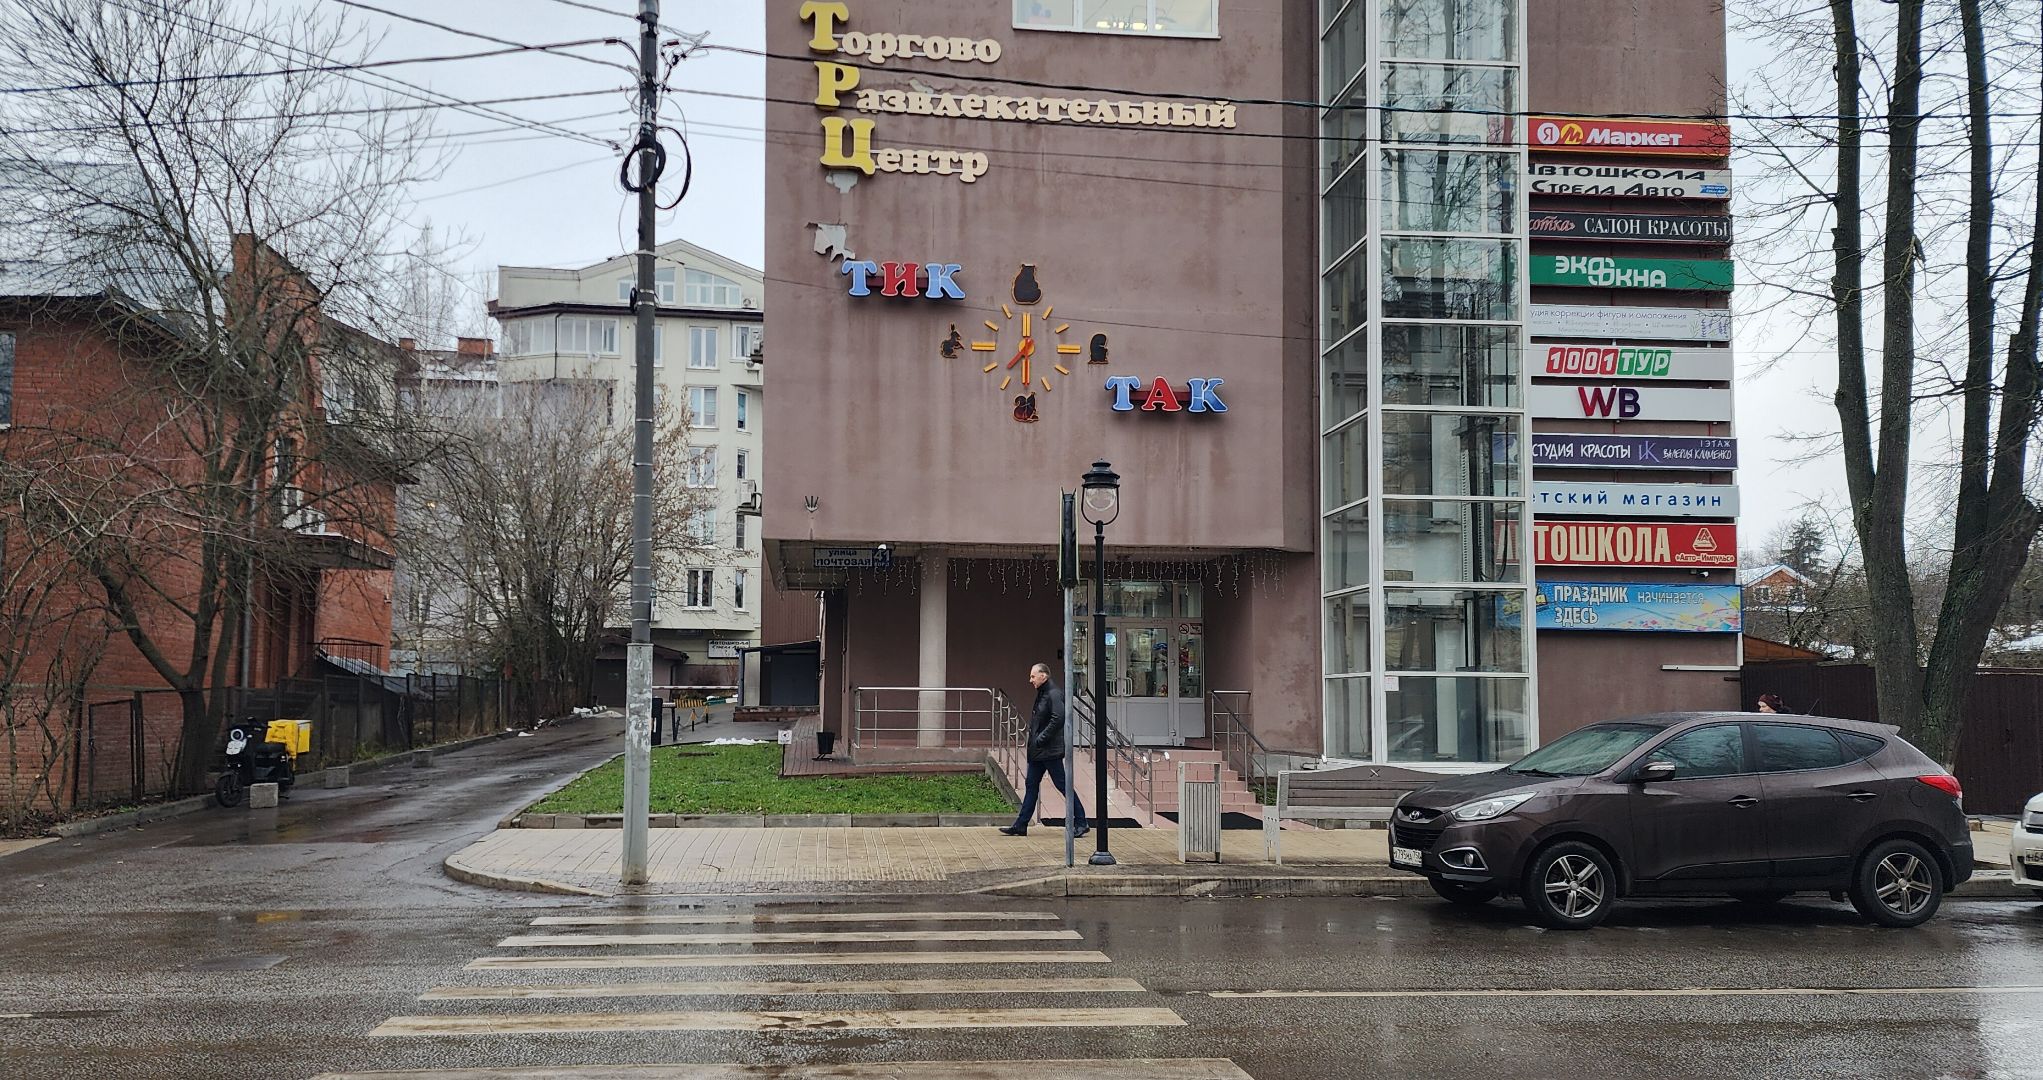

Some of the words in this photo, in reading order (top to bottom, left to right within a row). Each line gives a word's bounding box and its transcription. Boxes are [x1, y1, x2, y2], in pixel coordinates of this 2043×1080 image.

[800, 1, 1001, 64] Торгово
[814, 61, 1237, 128] Развлекательный
[1586, 128, 1682, 146] Маркет
[820, 117, 989, 183] Центр
[1584, 217, 1641, 234] САЛОН
[1647, 221, 1729, 237] КРАСОТЫ
[842, 260, 965, 299] ТИК
[1105, 375, 1229, 413] ТАК
[1578, 387, 1640, 417] WB
[1532, 443, 1573, 460] СТУДИЯ
[1581, 444, 1630, 459] КРАСОТЫ
[1705, 440, 1730, 448] ЭТАЖ
[1623, 493, 1721, 506] магазин
[816, 559, 872, 567] ПОЧТОВАЯ
[873, 549, 890, 561] 41
[828, 549, 857, 557] улица
[1554, 586, 1628, 604] ПРАЗДНИК
[1637, 591, 1704, 604] начинается
[1554, 608, 1598, 625] ЗДЕСЬ
